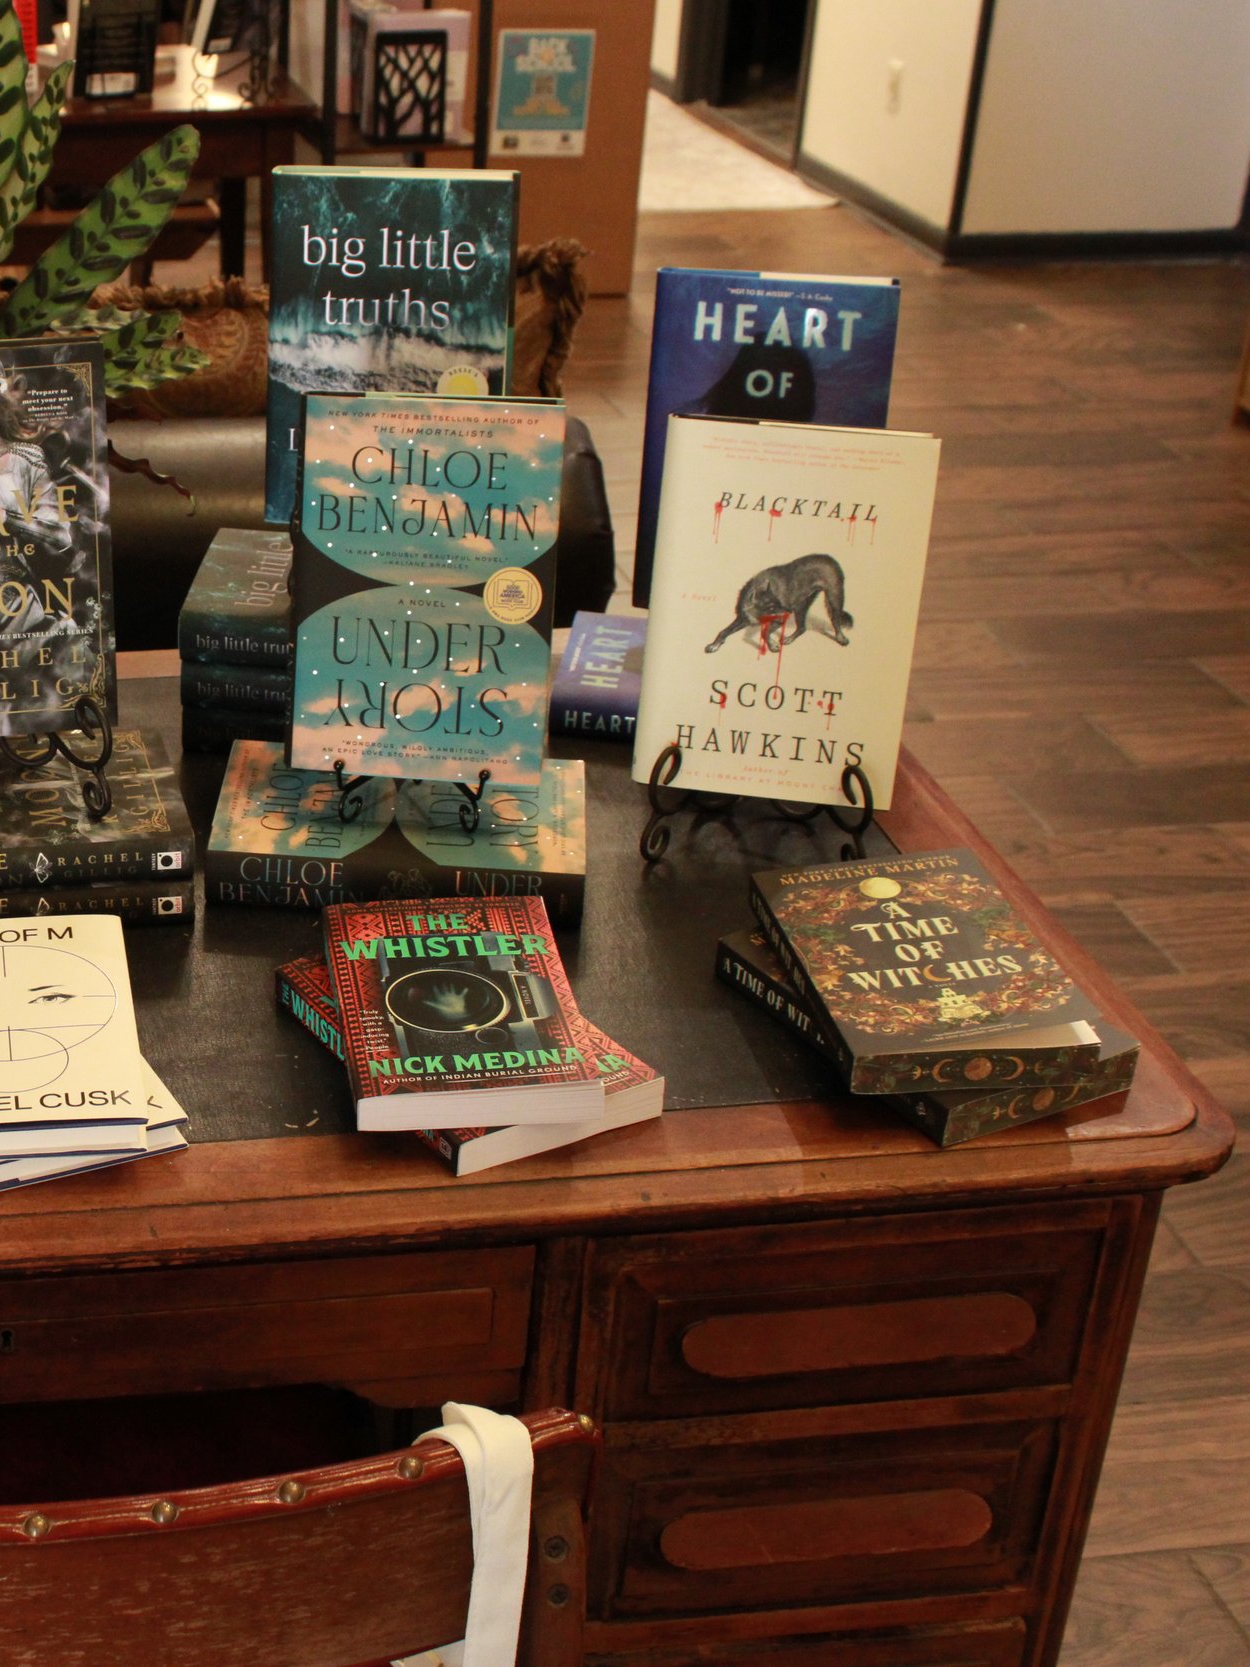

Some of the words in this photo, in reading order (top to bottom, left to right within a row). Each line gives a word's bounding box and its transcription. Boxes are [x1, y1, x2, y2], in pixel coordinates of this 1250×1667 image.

[302, 224, 366, 278] big
[379, 227, 476, 271] little
[322, 288, 451, 330] truths
[694, 301, 862, 351] HEART
[746, 369, 794, 398] OF
[374, 426, 395, 434] THE
[402, 428, 494, 438] IMMORTALISTS
[414, 414, 479, 423] BESTSELLING
[352, 446, 508, 490] CHLOE
[318, 494, 538, 541] BENJAMIN
[718, 491, 879, 522] BLACKTAIL
[247, 541, 294, 578] little
[234, 580, 288, 607] big
[409, 600, 446, 608] NOVEL
[12, 630, 65, 640] BESTSELLING
[67, 628, 94, 636] SERIES
[196, 634, 220, 650] big
[224, 635, 259, 654] little
[332, 616, 507, 675] UNDER
[580, 625, 632, 688] HEART
[197, 682, 220, 699] big
[225, 684, 260, 700] little
[710, 680, 842, 716] SCOTT
[324, 678, 508, 738] STORY
[564, 710, 636, 734] HEART
[676, 724, 864, 768] HAWKINS
[57, 852, 144, 866] RACHEL
[64, 866, 138, 878] GILLIG
[240, 856, 344, 887] CHLOE
[779, 868, 878, 886] MADELINE
[884, 858, 958, 874] MARTIN
[455, 870, 542, 899] UNDER
[58, 897, 144, 911] RACHEL
[880, 901, 912, 918] A
[48, 926, 74, 940] M
[406, 914, 469, 931] THE
[850, 916, 958, 942] TIME
[340, 934, 551, 961] WHISTLER
[894, 940, 944, 962] OF
[722, 957, 732, 974] A
[733, 962, 766, 998] TIME
[767, 990, 784, 1011] OF
[847, 955, 1023, 990] WITCHES
[368, 1056, 450, 1078] NICK
[453, 1048, 586, 1072] MEDINA
[383, 1076, 424, 1084] AUTHOR
[441, 1072, 482, 1080] INDIAN
[485, 1069, 524, 1078] BURIAL
[528, 1065, 577, 1074] GROUND
[40, 1090, 132, 1109] CUSK
